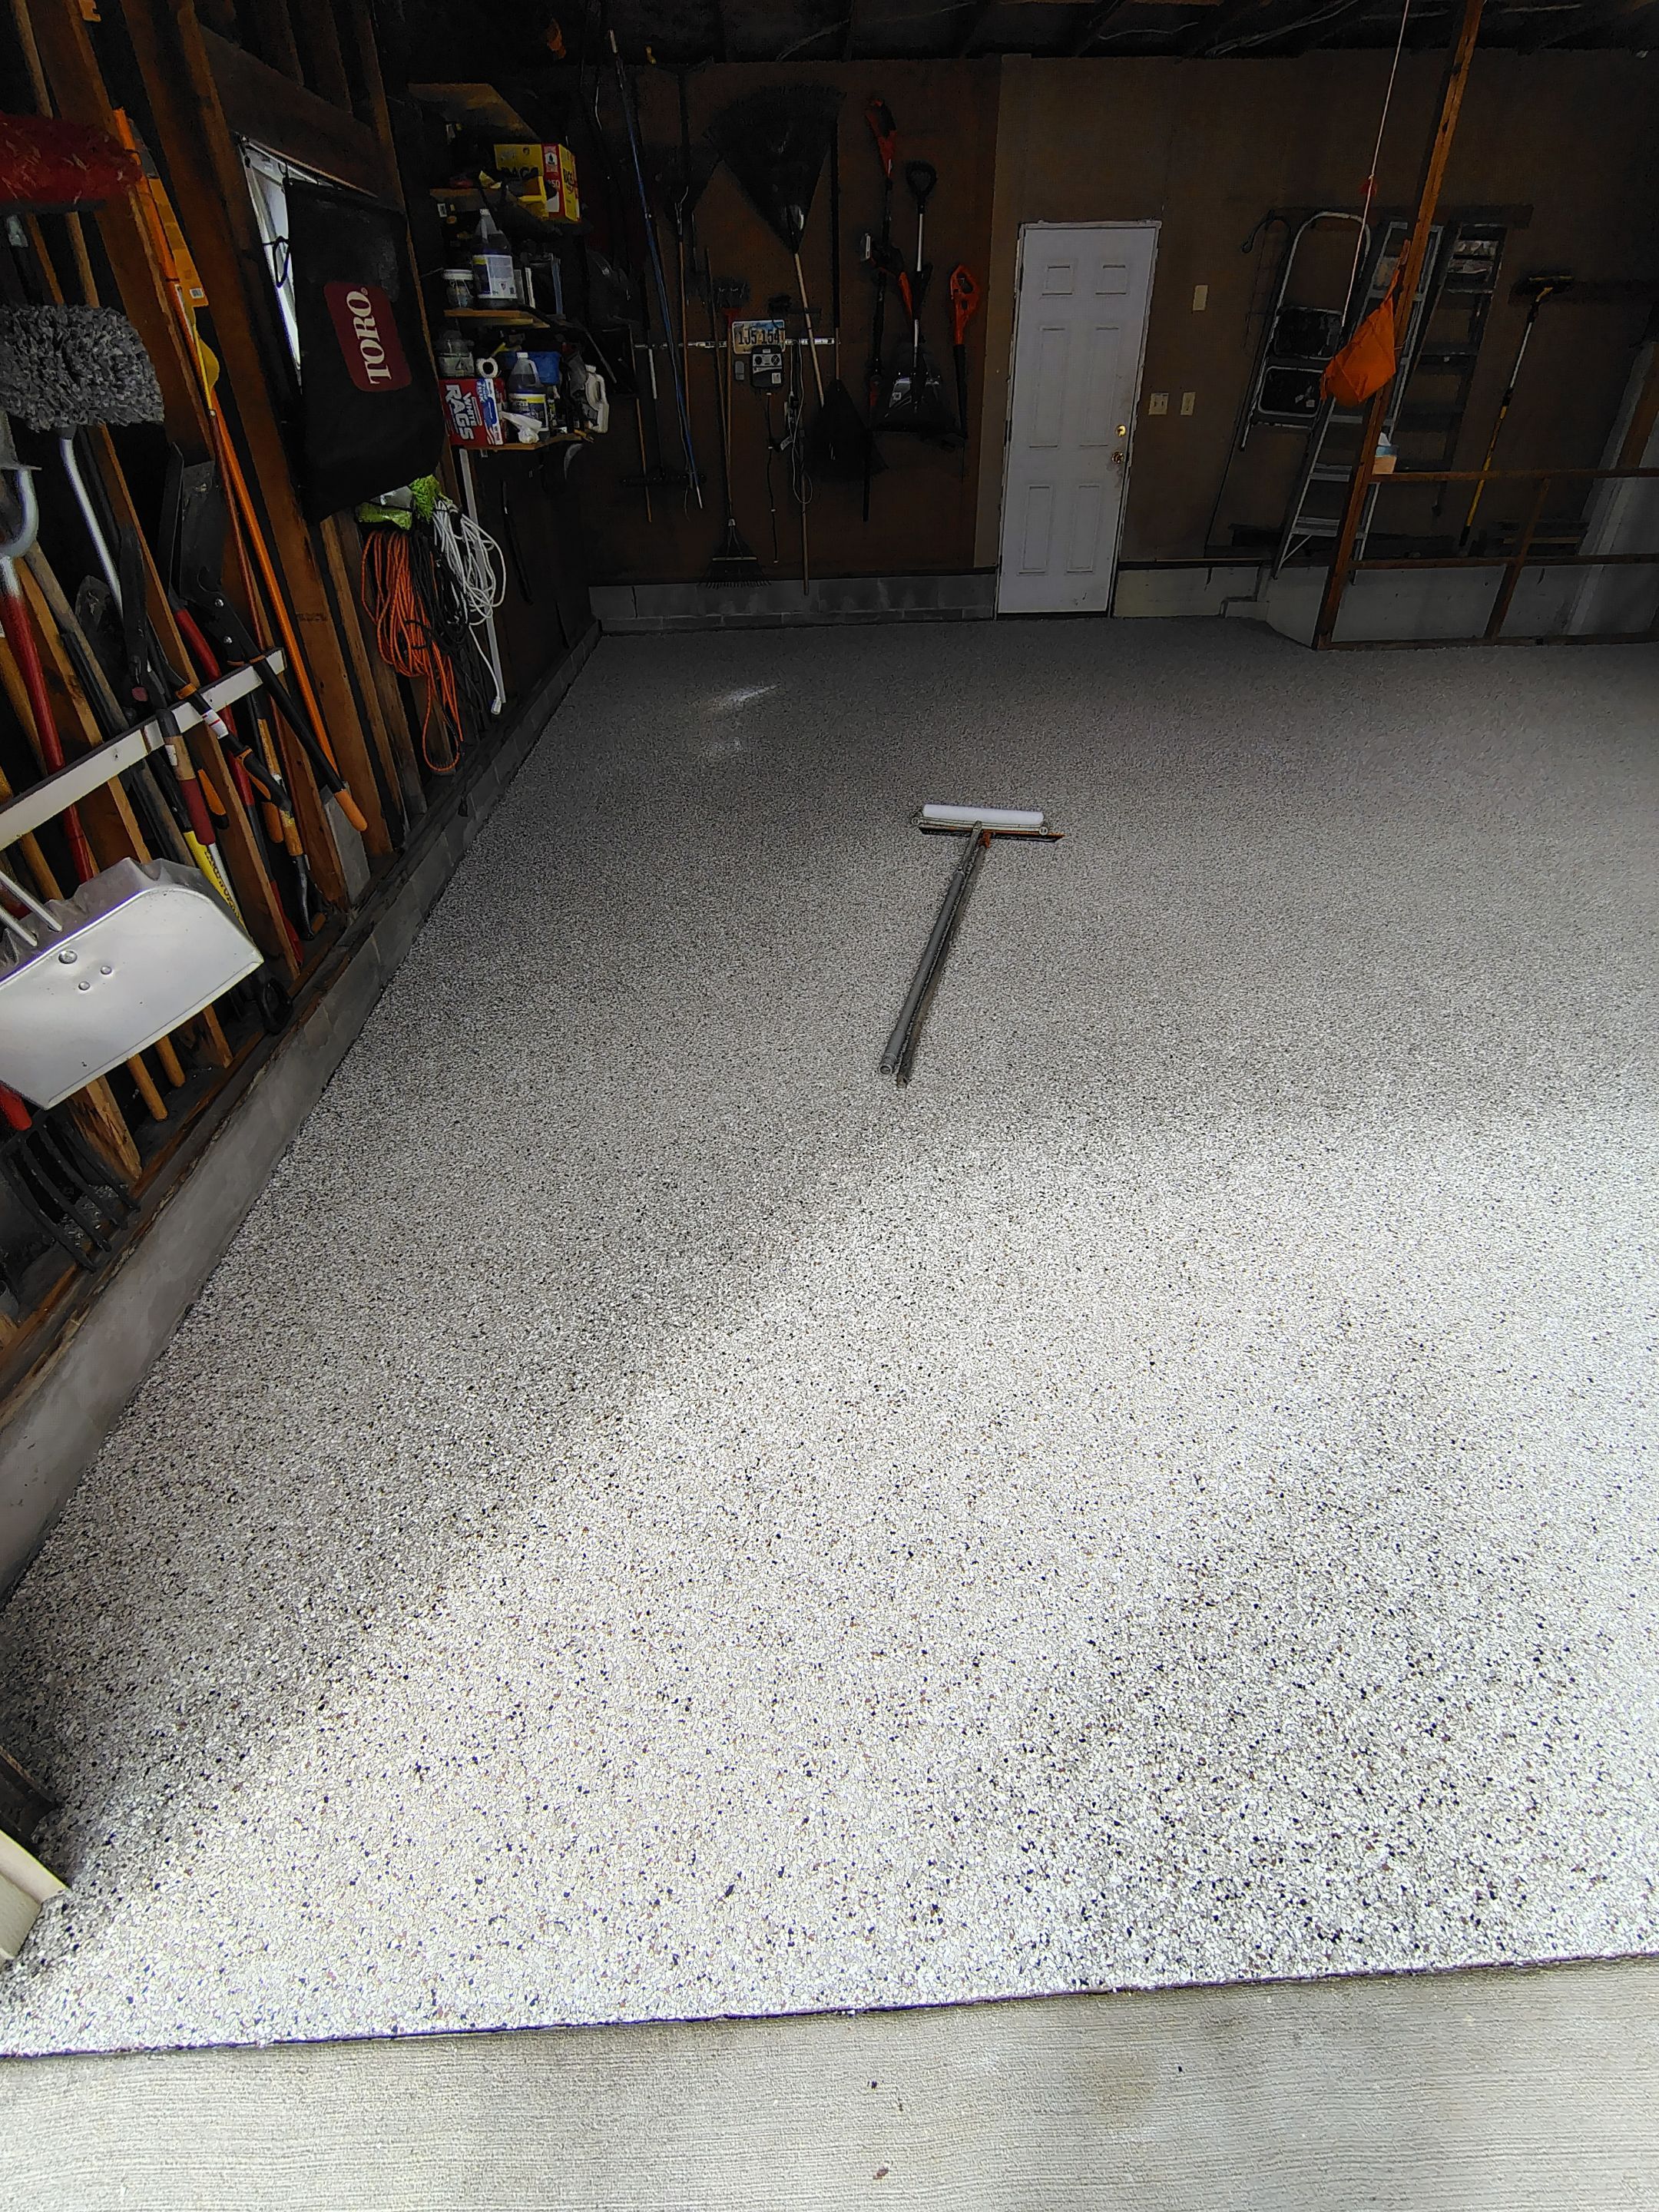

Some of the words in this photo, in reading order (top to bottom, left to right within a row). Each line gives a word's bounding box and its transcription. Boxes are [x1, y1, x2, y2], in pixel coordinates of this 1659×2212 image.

[346, 290, 392, 384] TORO
[761, 327, 780, 344] 154
[445, 384, 475, 439] RAGS
[462, 392, 477, 427] WHITE
